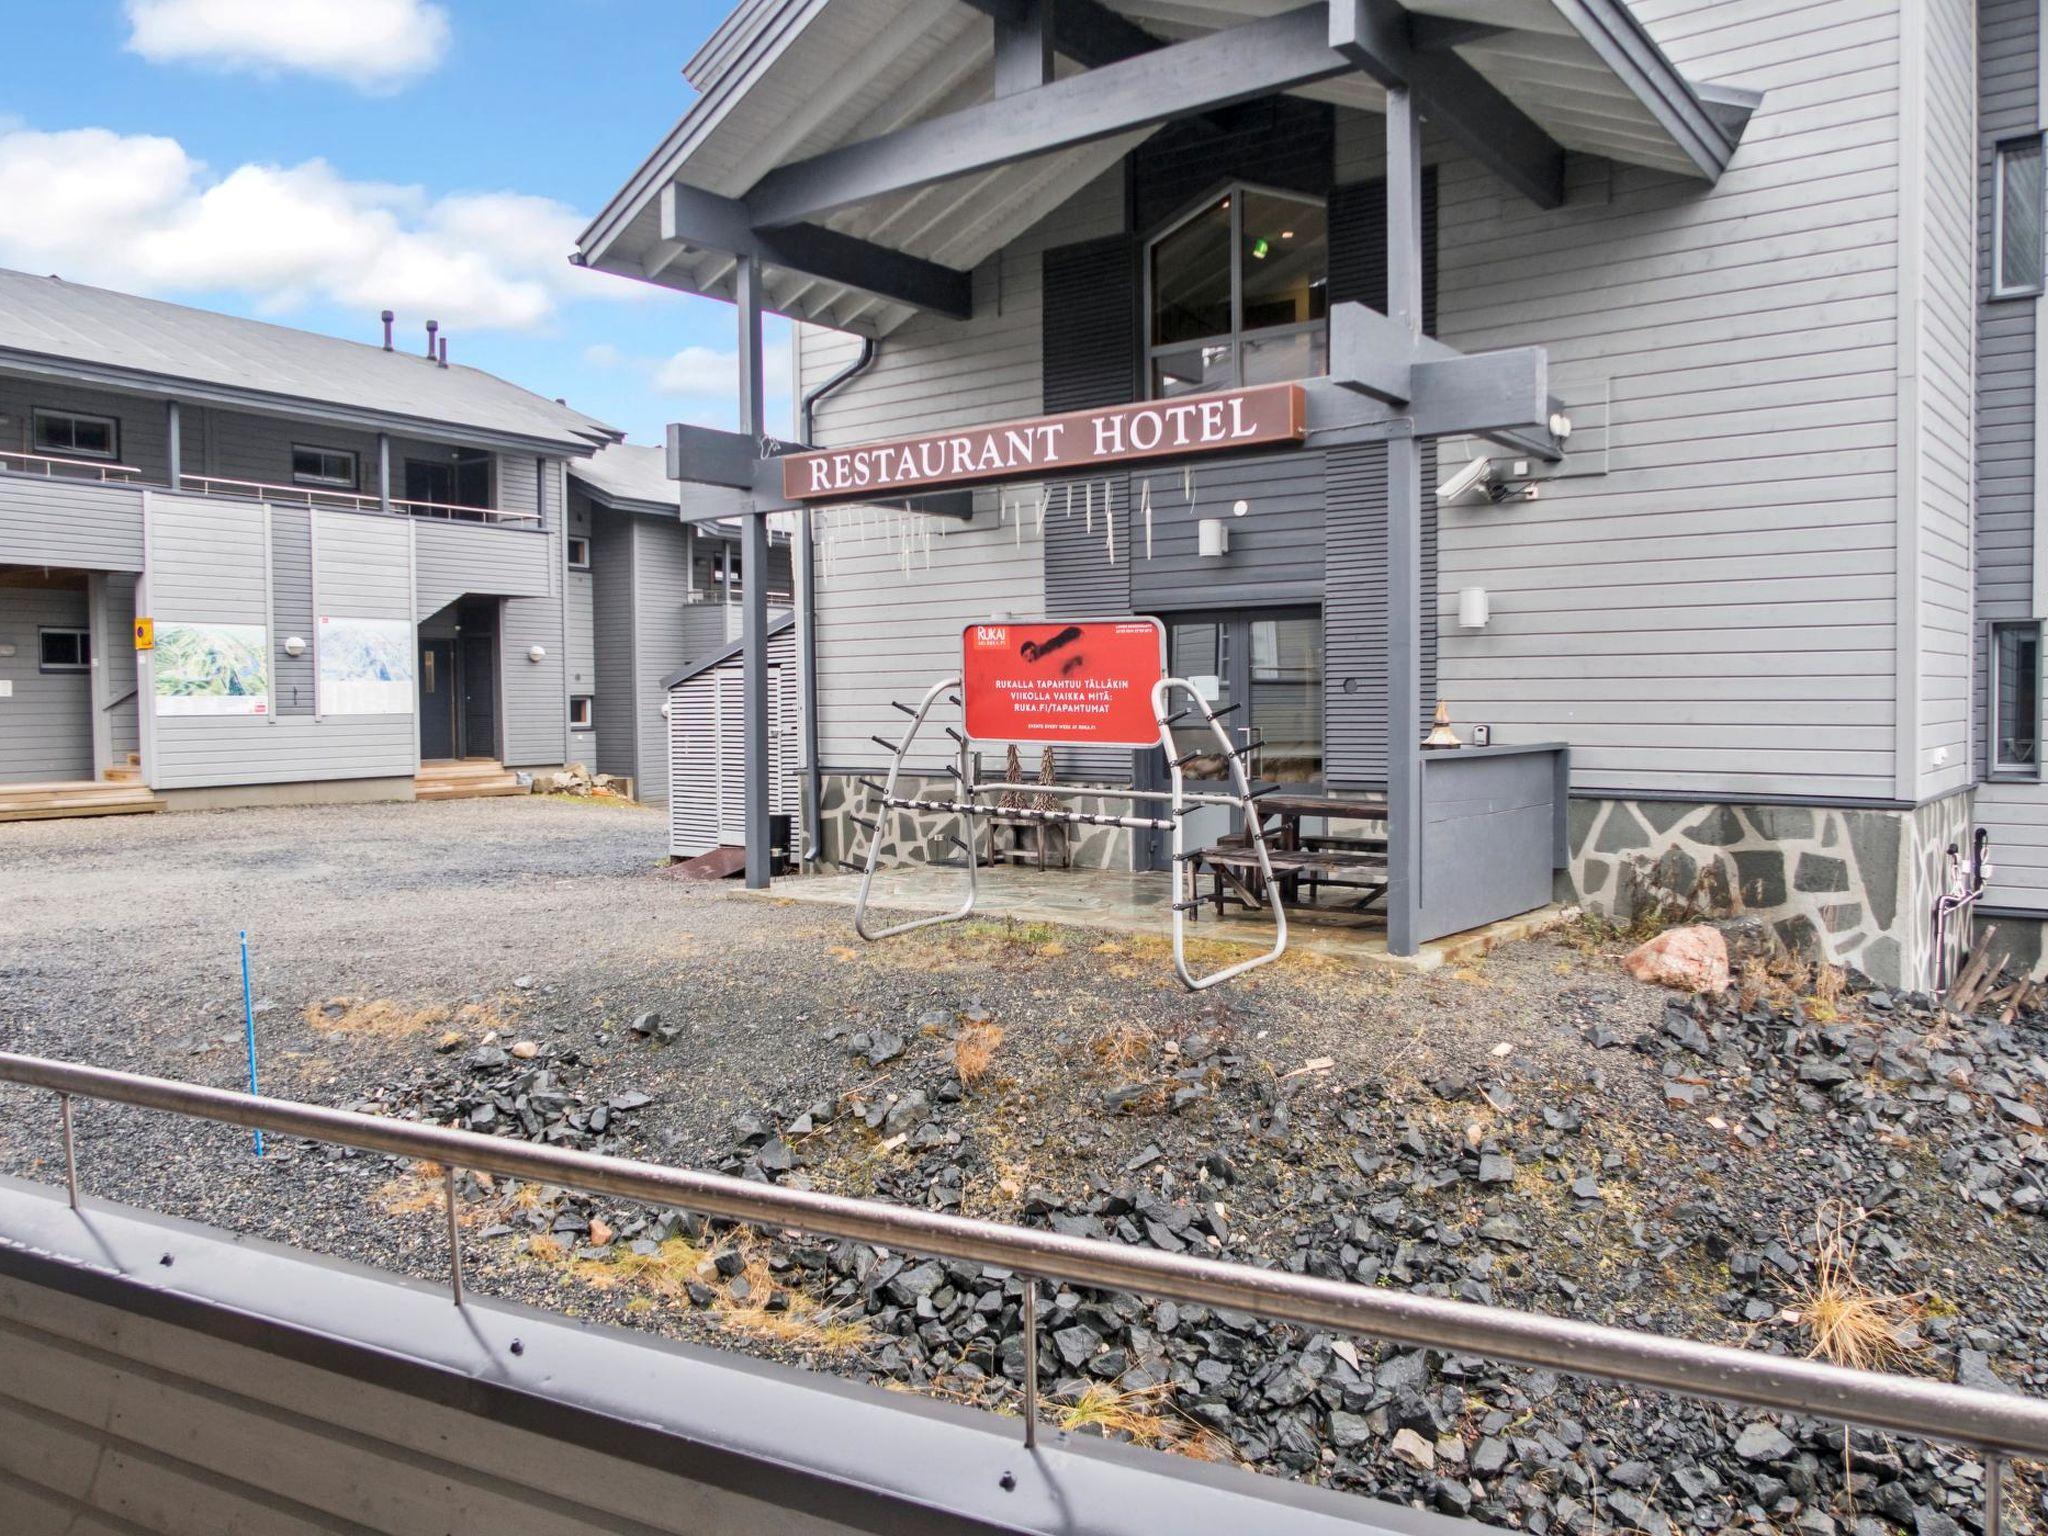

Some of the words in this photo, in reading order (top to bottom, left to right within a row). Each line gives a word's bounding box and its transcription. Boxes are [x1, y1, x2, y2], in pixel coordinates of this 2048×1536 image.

[808, 423, 1065, 493] RESTAURANT
[1091, 397, 1259, 456] HOTEL
[995, 680, 1034, 689] RUKALLA
[1036, 680, 1082, 689] TAPAHTUU
[1010, 692, 1051, 701] VIIKOLLA
[1053, 692, 1085, 701] VAIKKA
